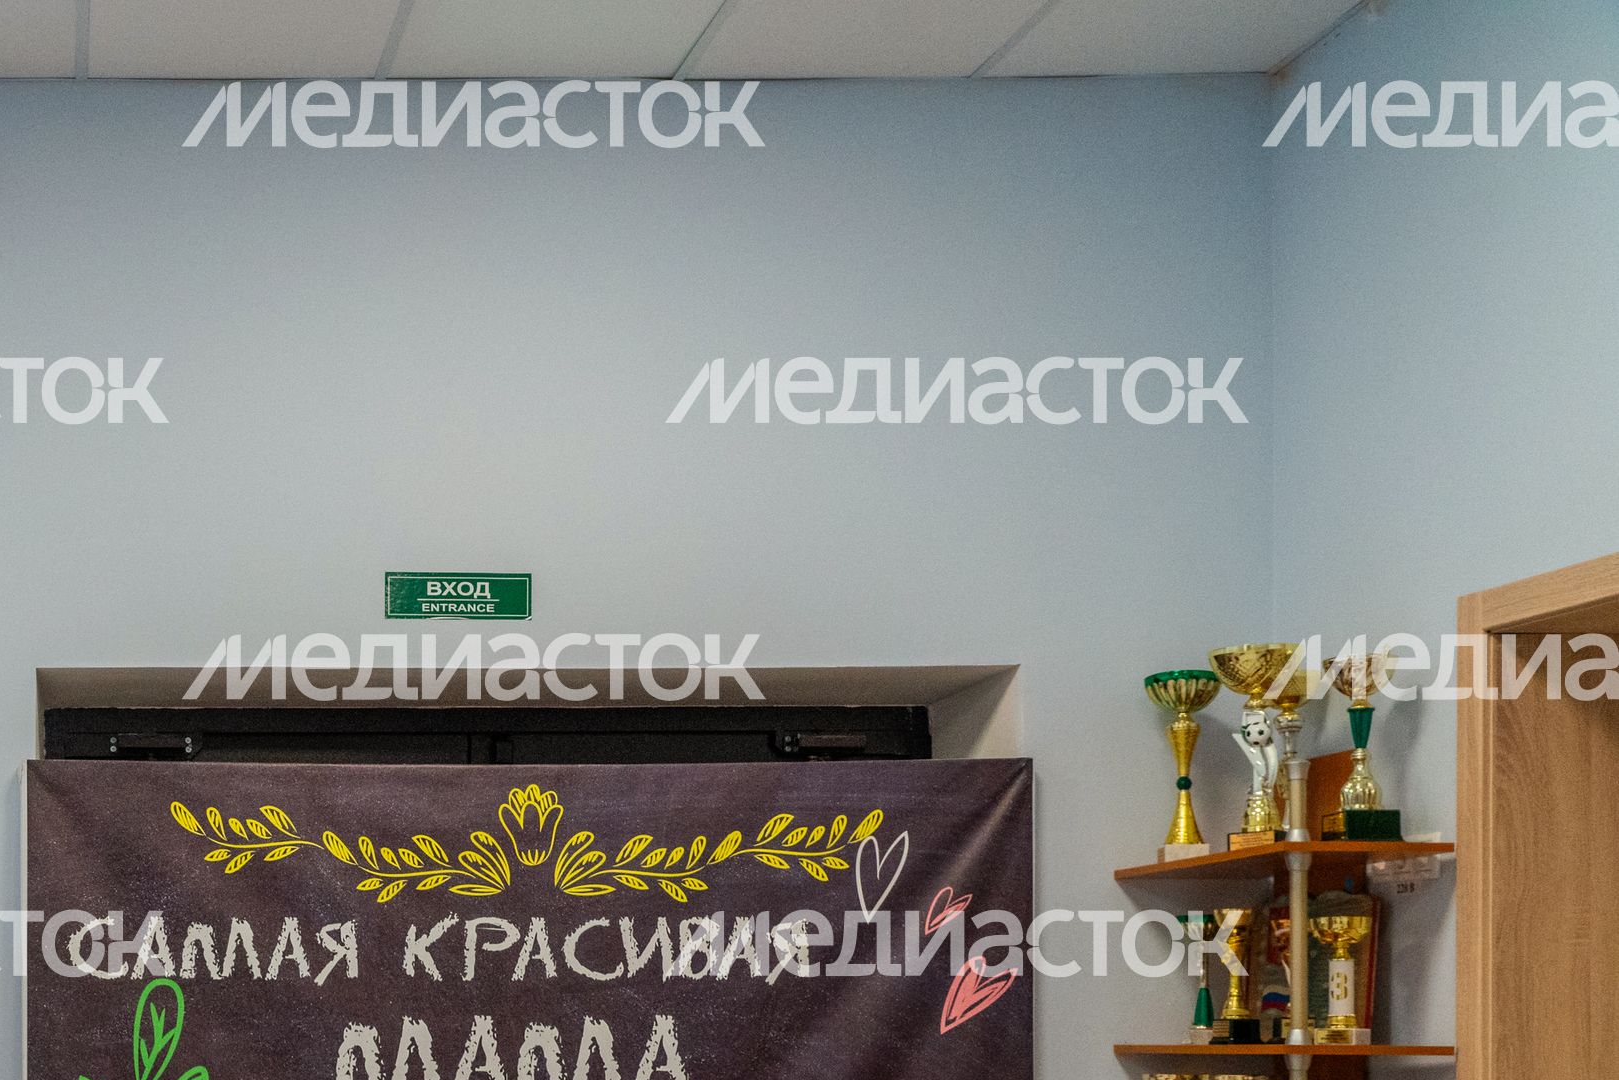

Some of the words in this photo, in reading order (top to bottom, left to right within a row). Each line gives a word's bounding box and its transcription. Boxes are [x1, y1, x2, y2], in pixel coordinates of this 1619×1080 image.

[427, 581, 491, 599] ВХОД
[422, 603, 495, 613] ENTRANCE
[68, 915, 360, 985] САМАЯ
[403, 911, 811, 986] КРАСИВАЯ
